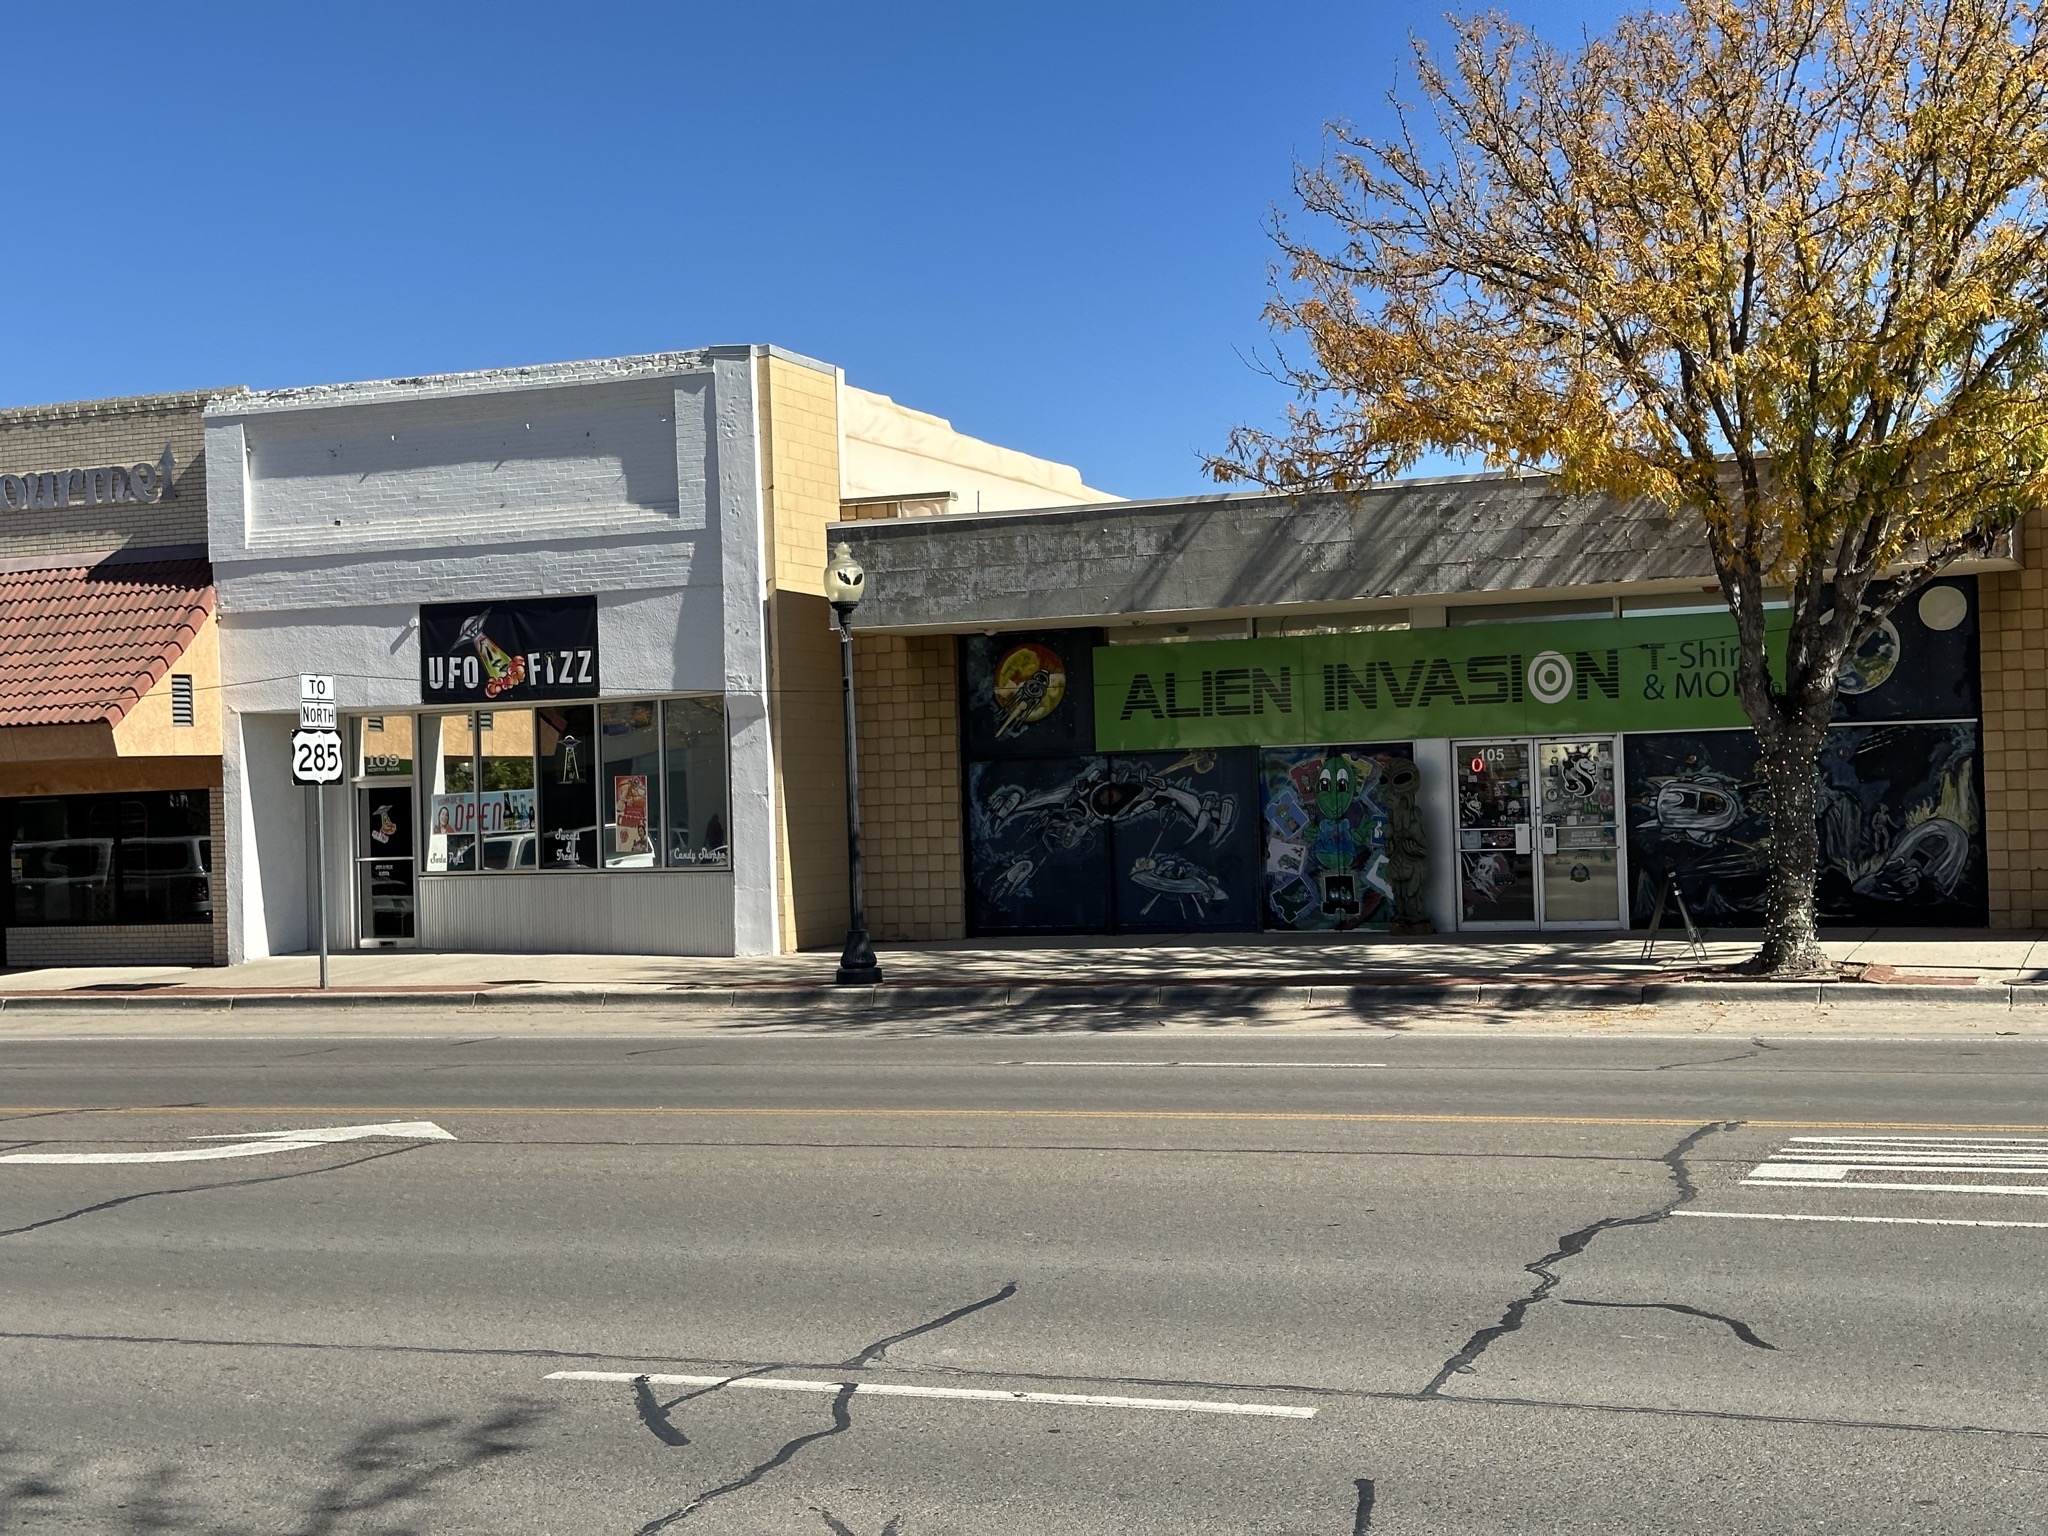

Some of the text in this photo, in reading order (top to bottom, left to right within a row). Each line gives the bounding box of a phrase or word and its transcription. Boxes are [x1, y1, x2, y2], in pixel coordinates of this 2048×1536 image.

[1639, 641, 1741, 671] T-Shir
[428, 655, 479, 690] UFO
[309, 679, 326, 695] TO
[1120, 649, 1619, 720] ALIEN INVASION
[1643, 673, 1665, 700] &
[303, 706, 334, 723] NORTH
[298, 743, 338, 772] 285
[367, 753, 400, 768] 109
[1478, 748, 1505, 761] 105
[455, 802, 503, 832] OPEN
[555, 827, 580, 841] Sweets
[556, 848, 580, 861] Treats
[566, 841, 572, 853] &
[674, 847, 726, 863] Candy Shoppe
[430, 852, 447, 864] Soda
